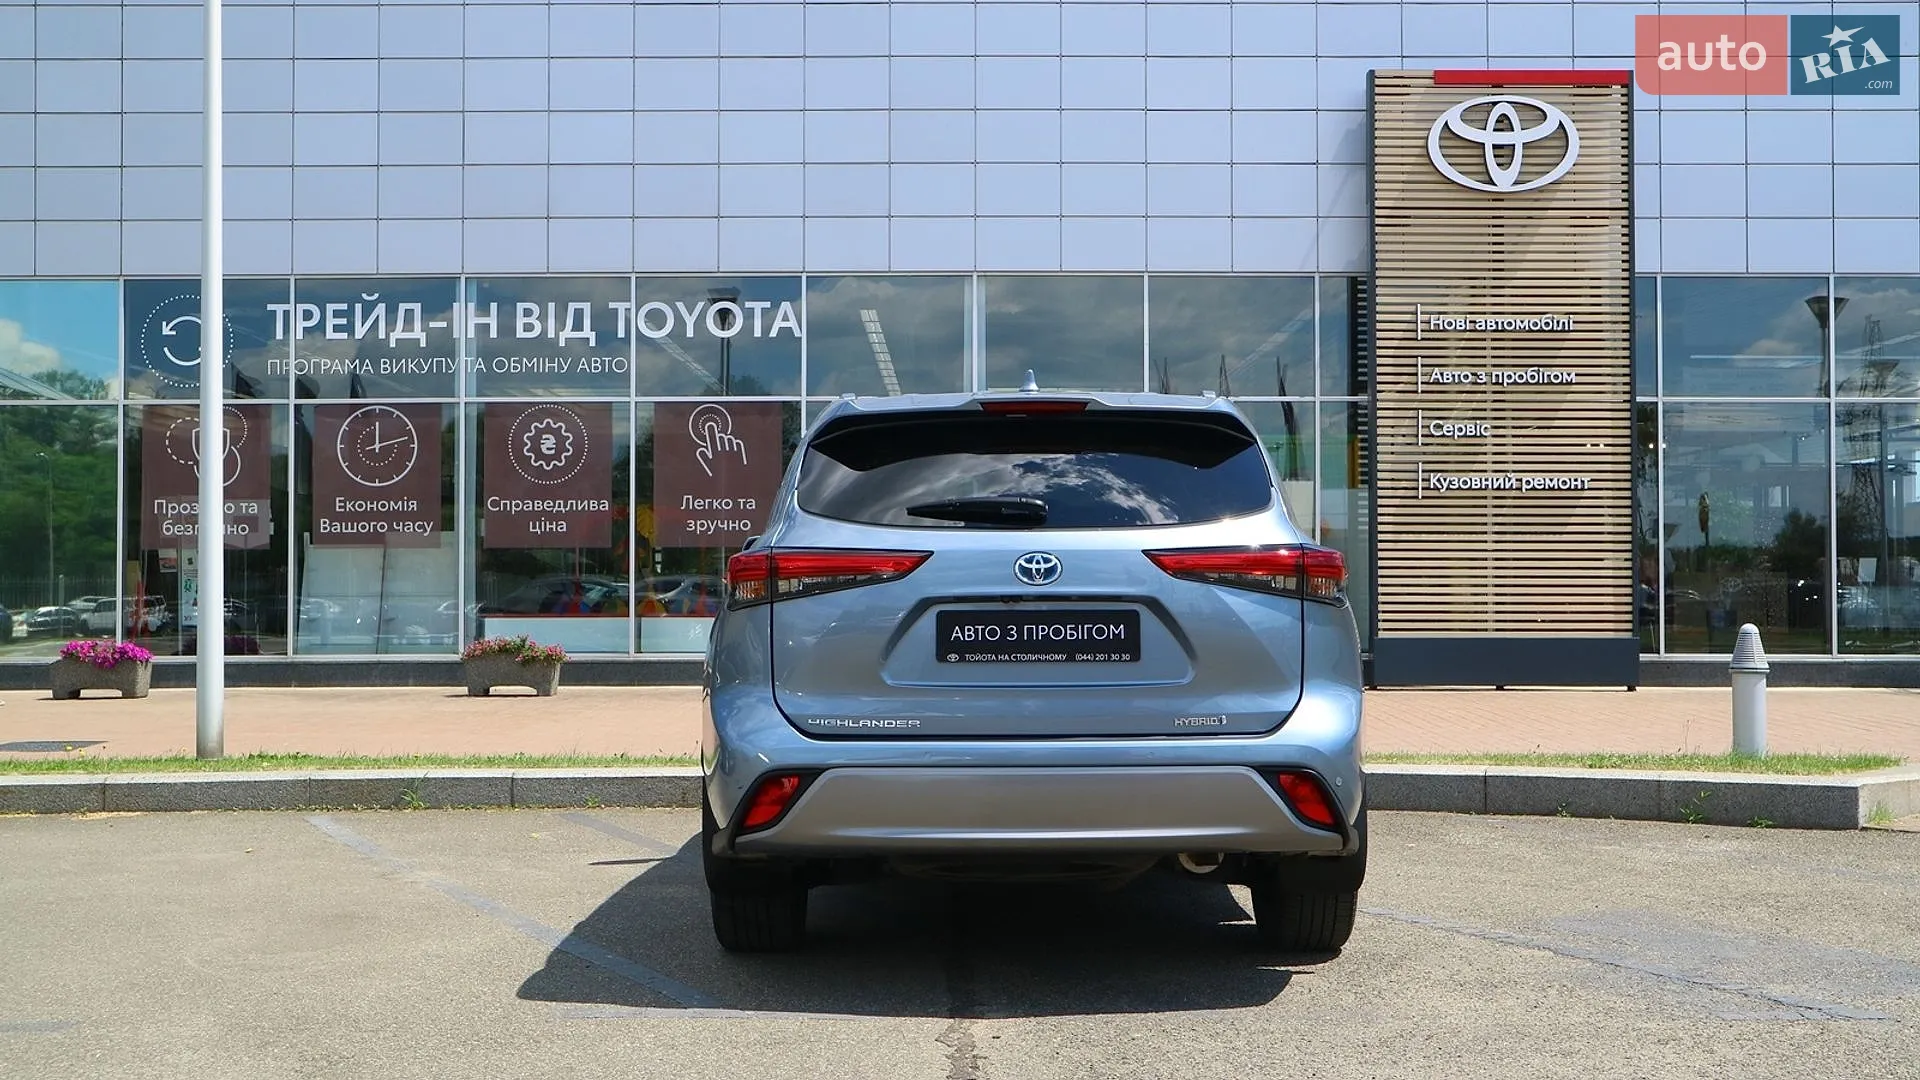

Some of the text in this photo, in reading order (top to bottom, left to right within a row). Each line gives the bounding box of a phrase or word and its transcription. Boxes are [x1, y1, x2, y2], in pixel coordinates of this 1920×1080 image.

[266, 293, 802, 348] ТРЕЙД-ІН ВІД TOYOTA
[1430, 314, 1574, 331] Нові автомобілі
[267, 357, 628, 376] ПРОГРАМА ВИКУПУ ТА ОБМІНУ АВТО
[1430, 367, 1576, 387] Авто з пробігом
[1430, 419, 1491, 439] Сервіс
[1430, 472, 1590, 492] Кузовний ремонт
[154, 500, 258, 518] Прозо та
[336, 496, 418, 513] Економія
[487, 496, 609, 514] Справедлива
[681, 495, 756, 510] Легко та
[162, 520, 249, 535] безно
[320, 518, 434, 535] Вашого часу
[529, 517, 567, 534] ціна
[686, 518, 751, 533] зручно
[951, 625, 1000, 641] АВТО
[1023, 624, 1125, 640] ПРОБІГОМ
[965, 653, 1131, 662] ТОЙОТА НА СТОЛИЧНОМУ (044) 201 30 30
[807, 718, 921, 728] HIGHLANDER
